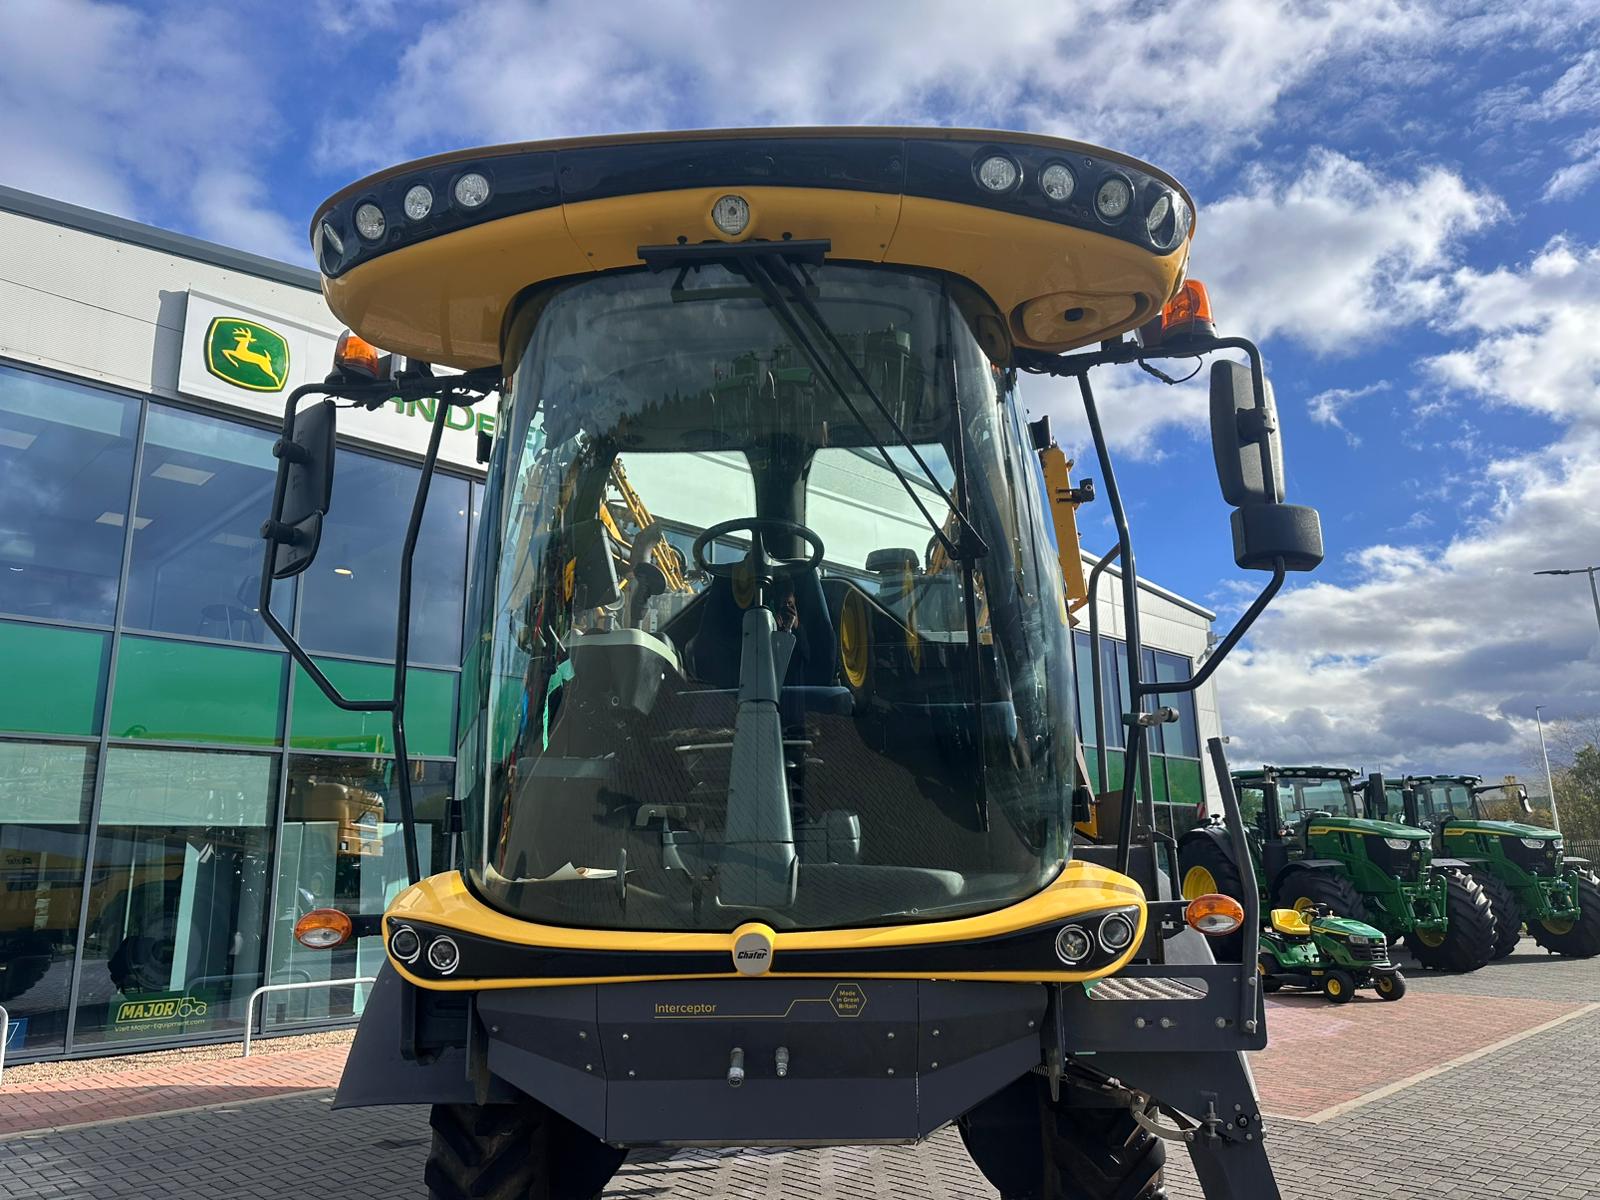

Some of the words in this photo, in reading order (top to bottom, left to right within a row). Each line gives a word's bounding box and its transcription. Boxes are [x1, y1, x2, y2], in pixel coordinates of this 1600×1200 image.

[737, 950, 768, 960] Chafer
[121, 1002, 174, 1019] MAJOR
[654, 1002, 717, 1015] Interceptor
